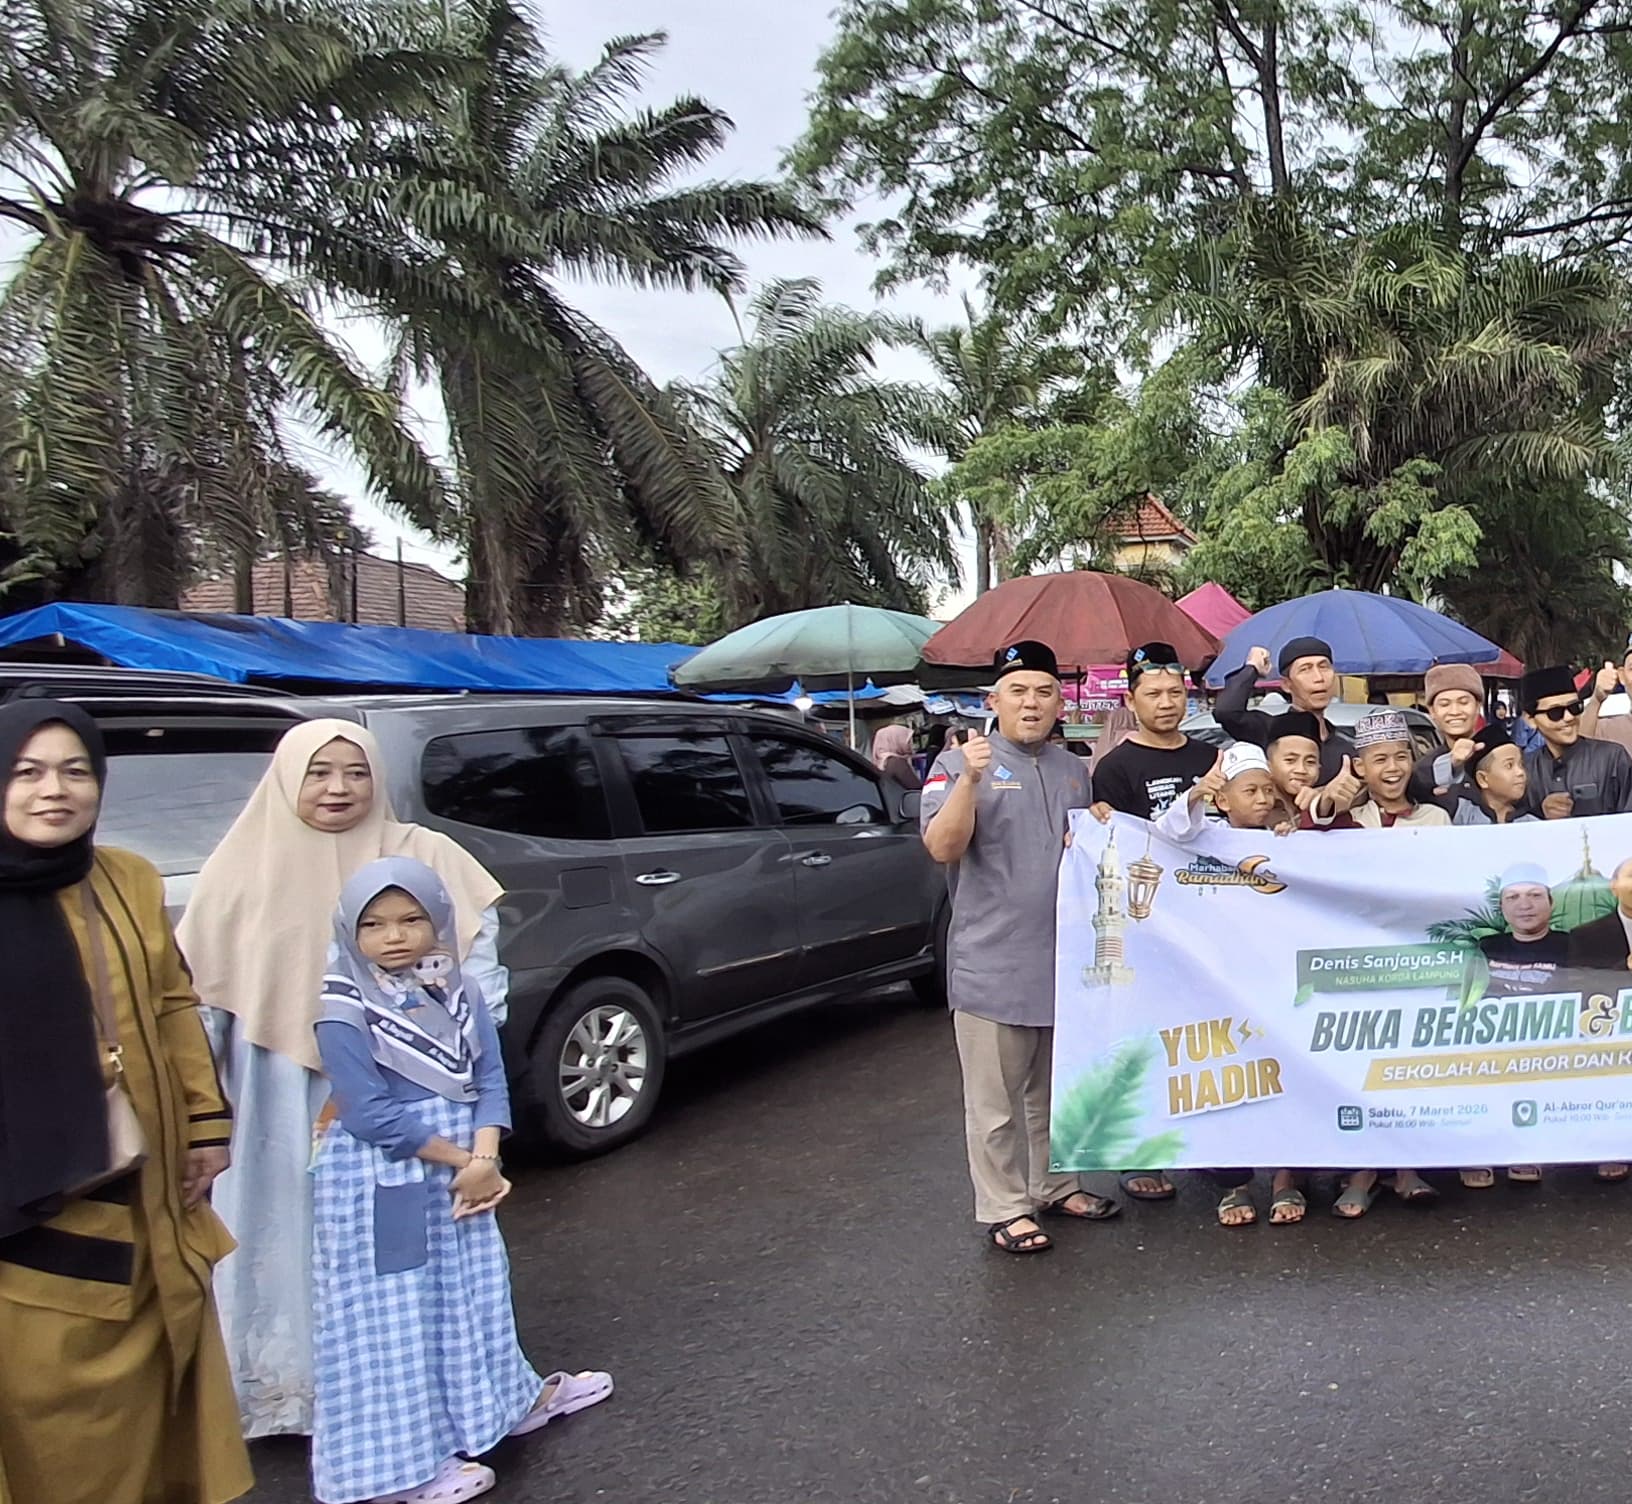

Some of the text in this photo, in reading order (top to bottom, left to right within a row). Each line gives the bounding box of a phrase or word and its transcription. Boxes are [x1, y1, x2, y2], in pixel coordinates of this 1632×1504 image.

[1311, 950, 1464, 972] Denis Sanjaya,S.H
[1336, 975, 1376, 986] NASUHA
[1413, 970, 1460, 981] LAMPUNG
[1310, 1008, 1402, 1052] BUKA
[1411, 999, 1575, 1048] BERSAMA
[1580, 994, 1619, 1037] &
[1159, 1017, 1237, 1067] YUK
[1382, 1063, 1472, 1082] SEKOLAH
[1477, 1062, 1500, 1077] AL
[1506, 1056, 1568, 1074] ABROR
[1574, 1053, 1615, 1069] DAN
[1168, 1058, 1283, 1115] HADIR
[1368, 1107, 1406, 1119] Sabtu,
[1410, 1106, 1416, 1116] 7
[1420, 1105, 1454, 1116] Maret
